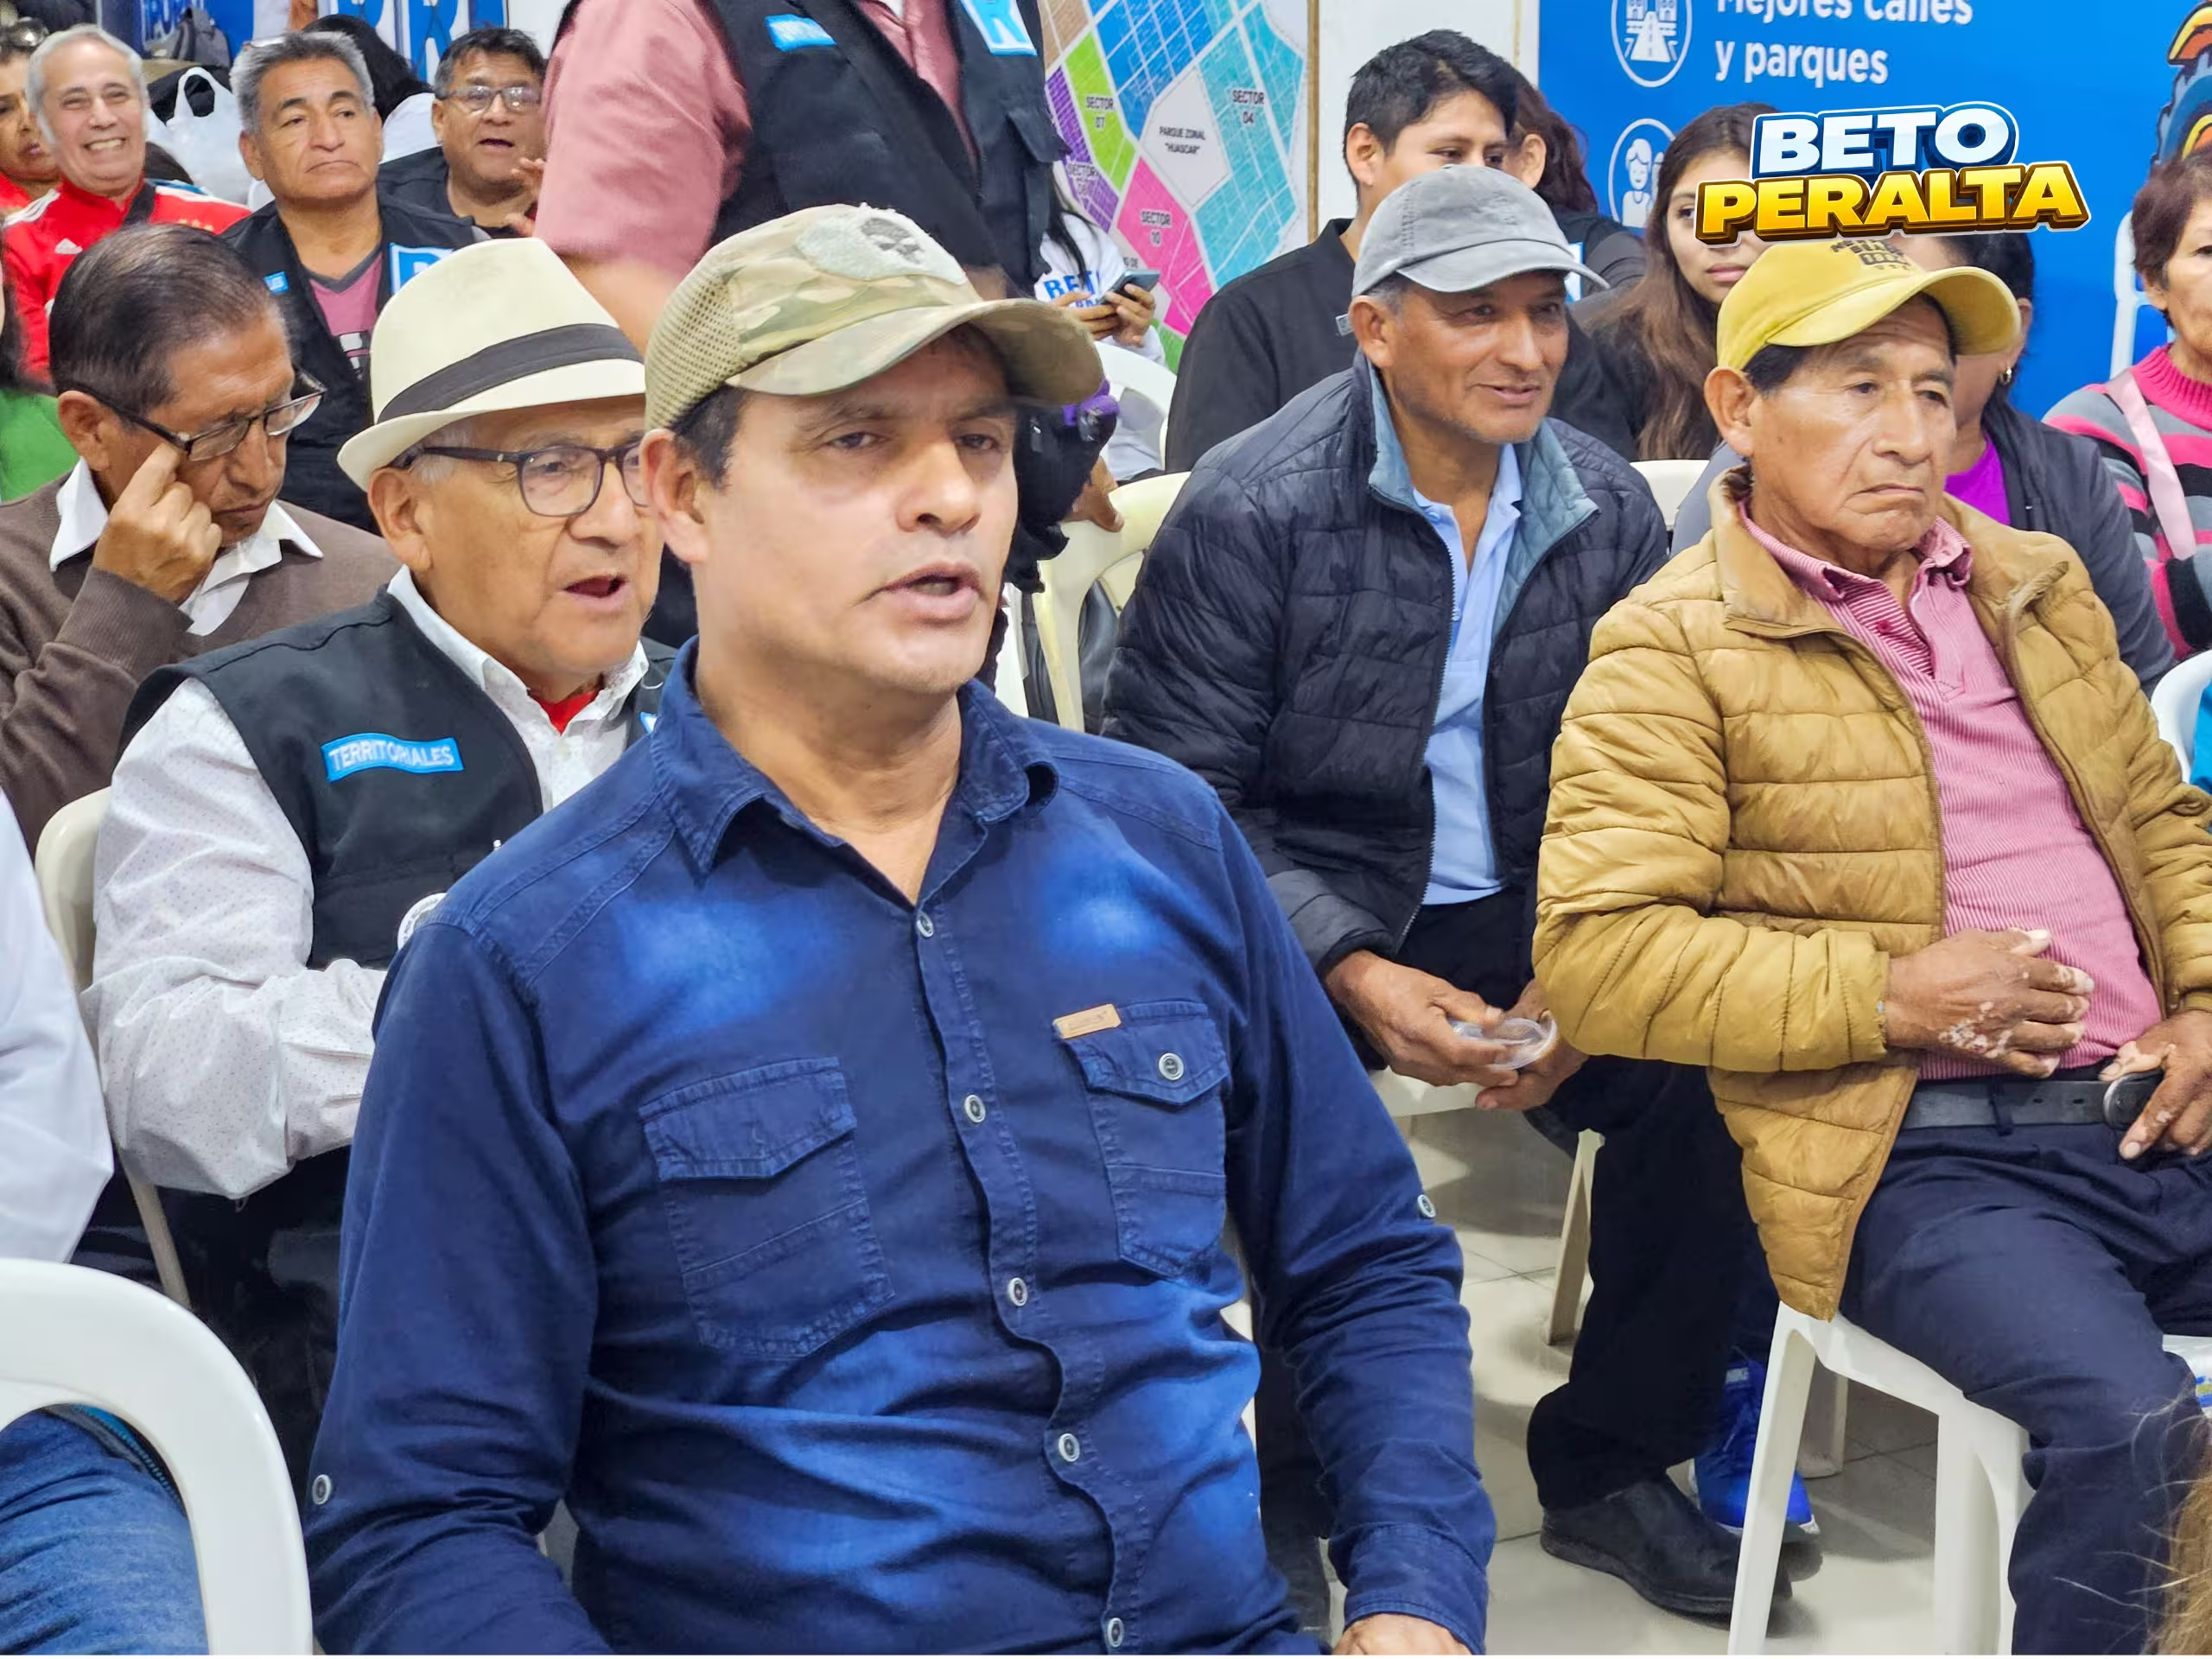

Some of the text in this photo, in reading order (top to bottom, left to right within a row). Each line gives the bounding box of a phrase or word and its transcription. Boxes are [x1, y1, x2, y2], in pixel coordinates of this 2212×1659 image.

[1714, 40, 1890, 89] y parques
[1086, 96, 1114, 110] SECTOR
[1232, 89, 1265, 105] SECTOR
[1243, 111, 1254, 124] 04
[1141, 210, 1171, 226] SECTOR
[327, 738, 455, 772] TERRITORIALES
